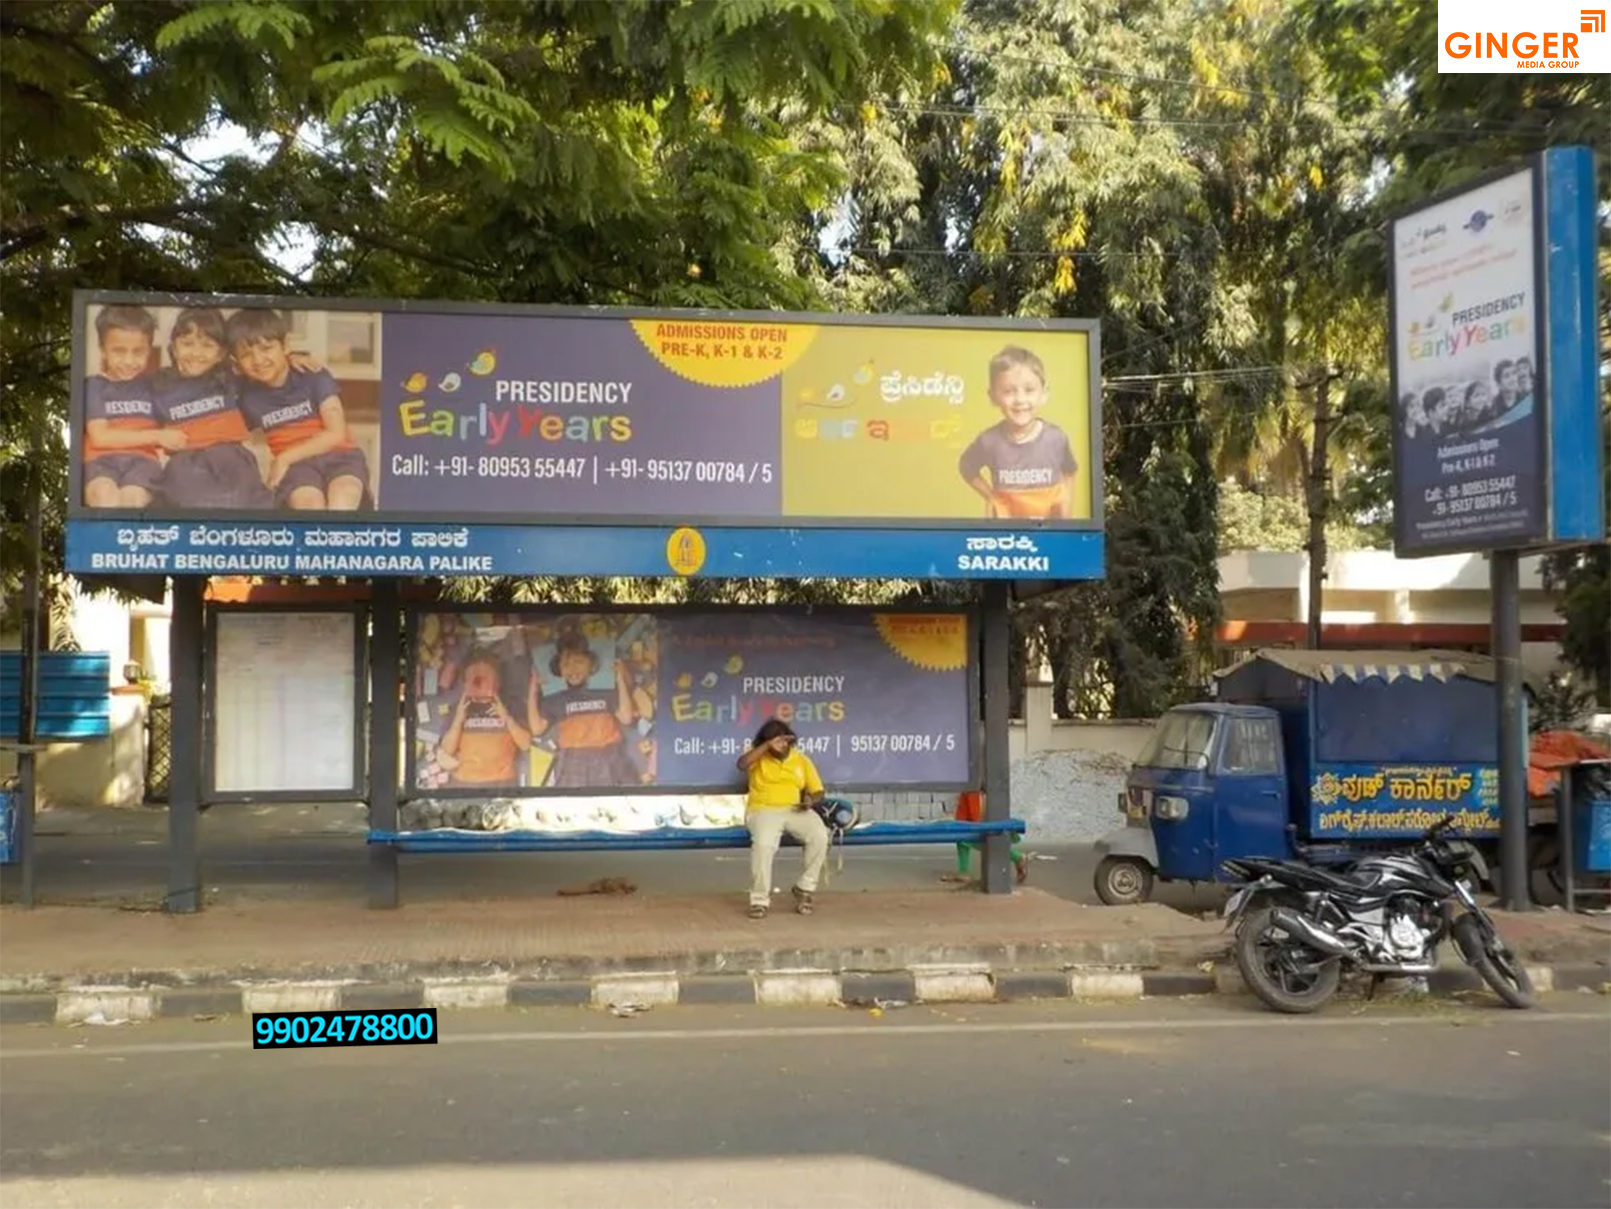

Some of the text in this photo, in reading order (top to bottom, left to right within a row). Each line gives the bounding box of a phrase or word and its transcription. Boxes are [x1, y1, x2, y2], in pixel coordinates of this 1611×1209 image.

[1452, 291, 1525, 326] PRESIDENCY
[657, 323, 787, 342] ADMISSIONS OPEN
[661, 342, 783, 360] PRE-K, K-1 & K-2
[495, 380, 632, 404] PRESIDENCY
[399, 399, 632, 446] Early Years
[392, 454, 429, 476] Call:
[434, 455, 474, 477] +91-
[478, 456, 530, 478] 80953
[534, 457, 586, 479] 55447
[604, 458, 644, 478] +91-
[647, 459, 693, 481] 95137
[696, 461, 744, 482] 00784
[762, 463, 772, 483] 5
[117, 525, 469, 552] ಬೃಹತ್ ಬೆಂಗಳೂರು ಮಹಾನಗರ ಪಾಲಿಕೆ
[91, 554, 492, 571] BRUHAT BENGALURU MAHANAGARA PALIKE
[958, 554, 1049, 572] SARAKKI
[743, 676, 845, 694] PRESIDENCY
[671, 692, 755, 728] Early
[674, 737, 704, 755] Call:
[708, 738, 740, 754] +91-
[851, 735, 888, 752] 95137
[890, 734, 931, 751] 00784
[946, 734, 956, 750] 5
